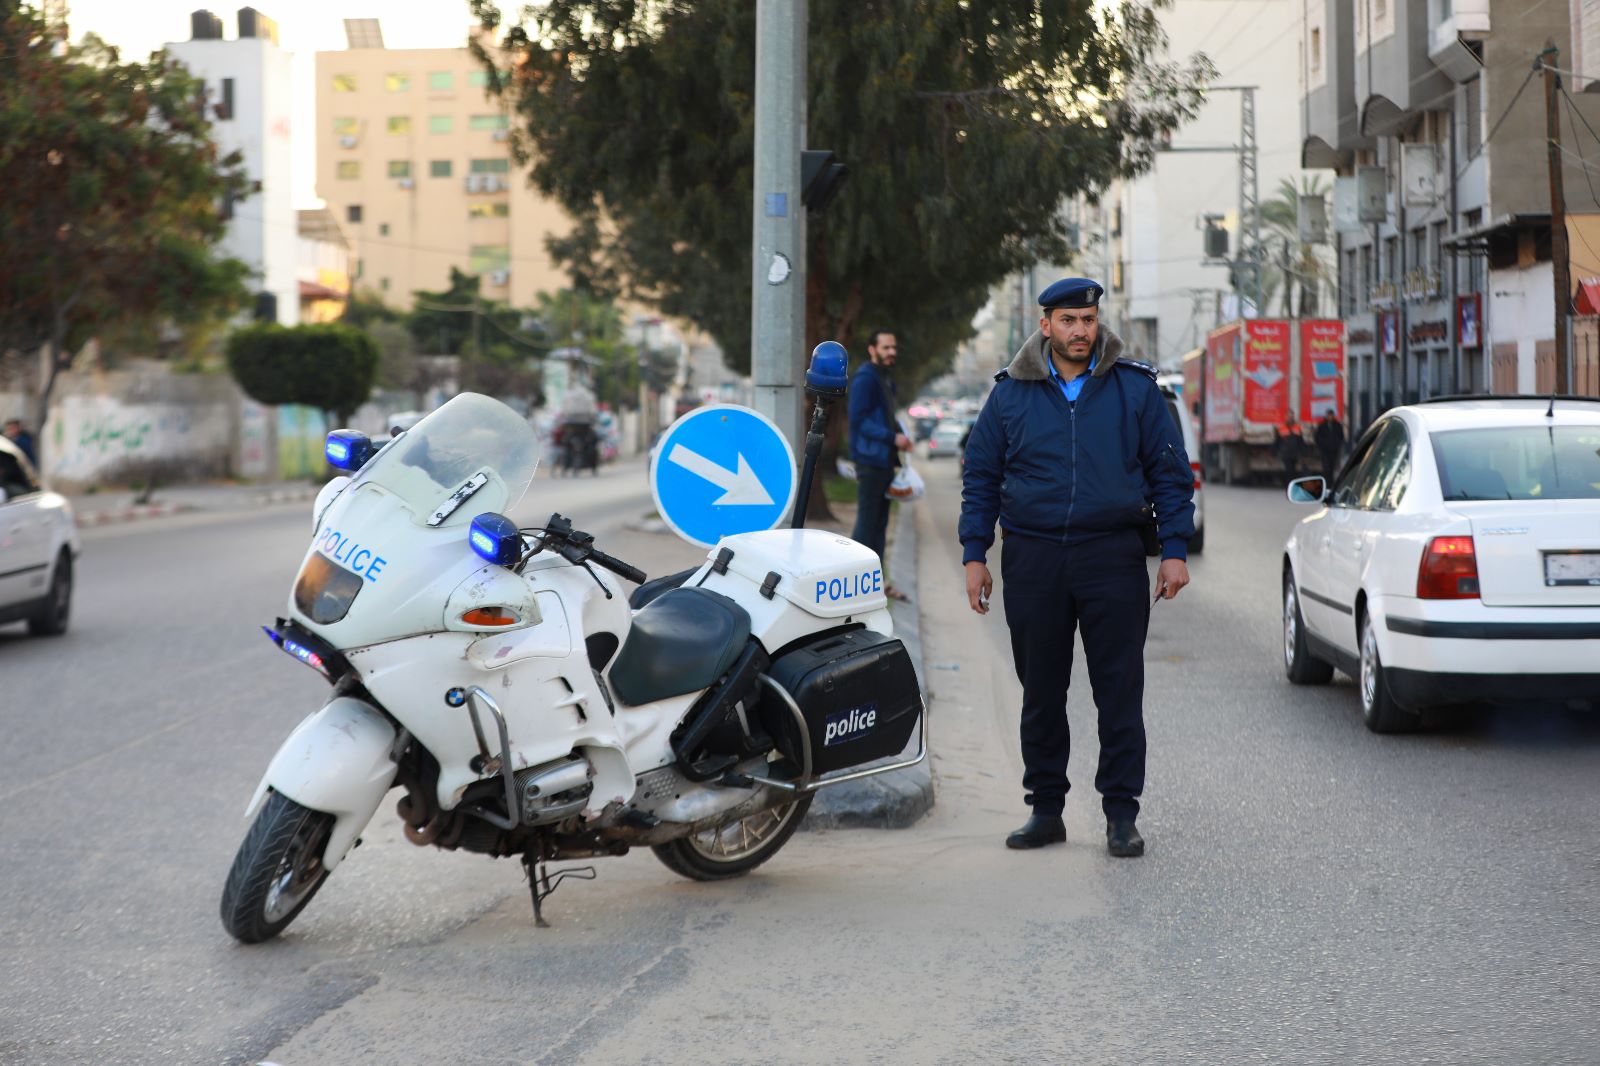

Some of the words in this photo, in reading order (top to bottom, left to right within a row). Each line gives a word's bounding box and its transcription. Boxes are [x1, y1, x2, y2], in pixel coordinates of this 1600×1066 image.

[315, 527, 387, 582] POLICE
[816, 570, 880, 603] POLICE
[824, 709, 876, 746] police
